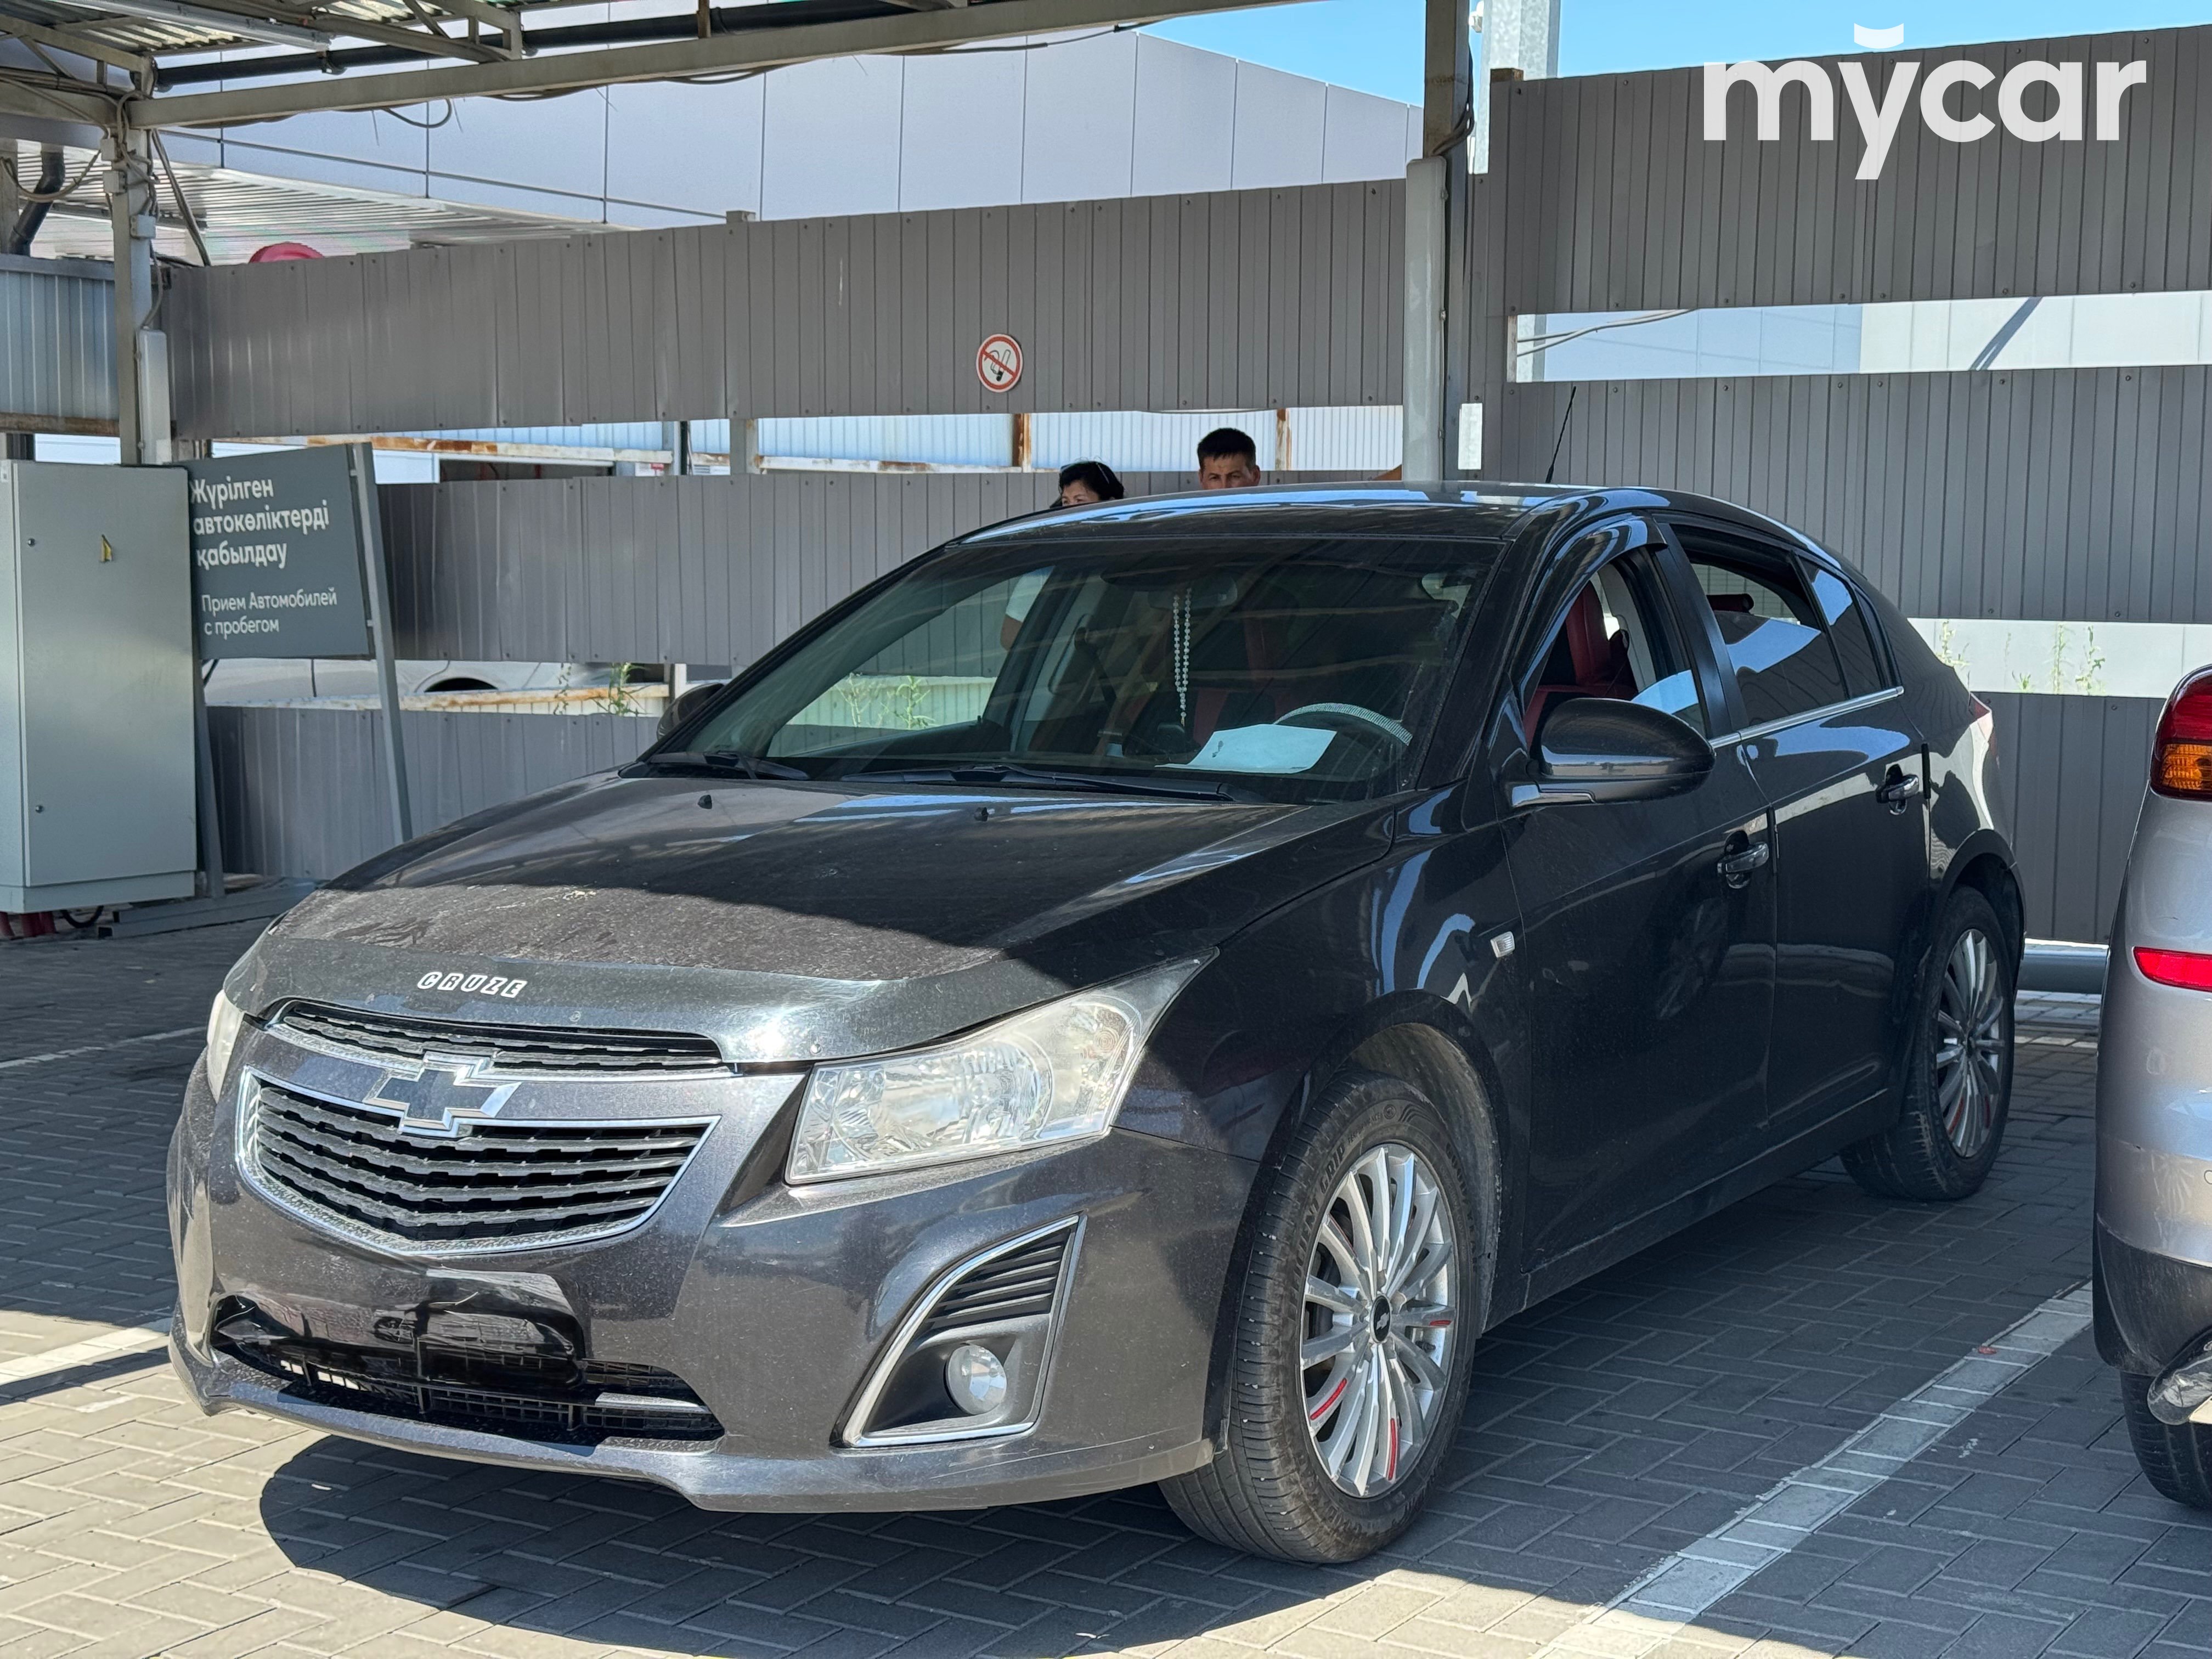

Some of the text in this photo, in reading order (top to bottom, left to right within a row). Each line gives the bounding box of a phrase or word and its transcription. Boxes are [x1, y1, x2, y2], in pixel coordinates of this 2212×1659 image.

[189, 475, 274, 510] Жүрілген
[193, 499, 330, 535] автокөліктерді
[196, 540, 287, 571] қабылдау
[201, 586, 338, 617] Прием Автомобилей
[204, 615, 280, 640] с пробегом
[417, 971, 528, 998] CRUZE
[1319, 1144, 1346, 1194] GRIP
